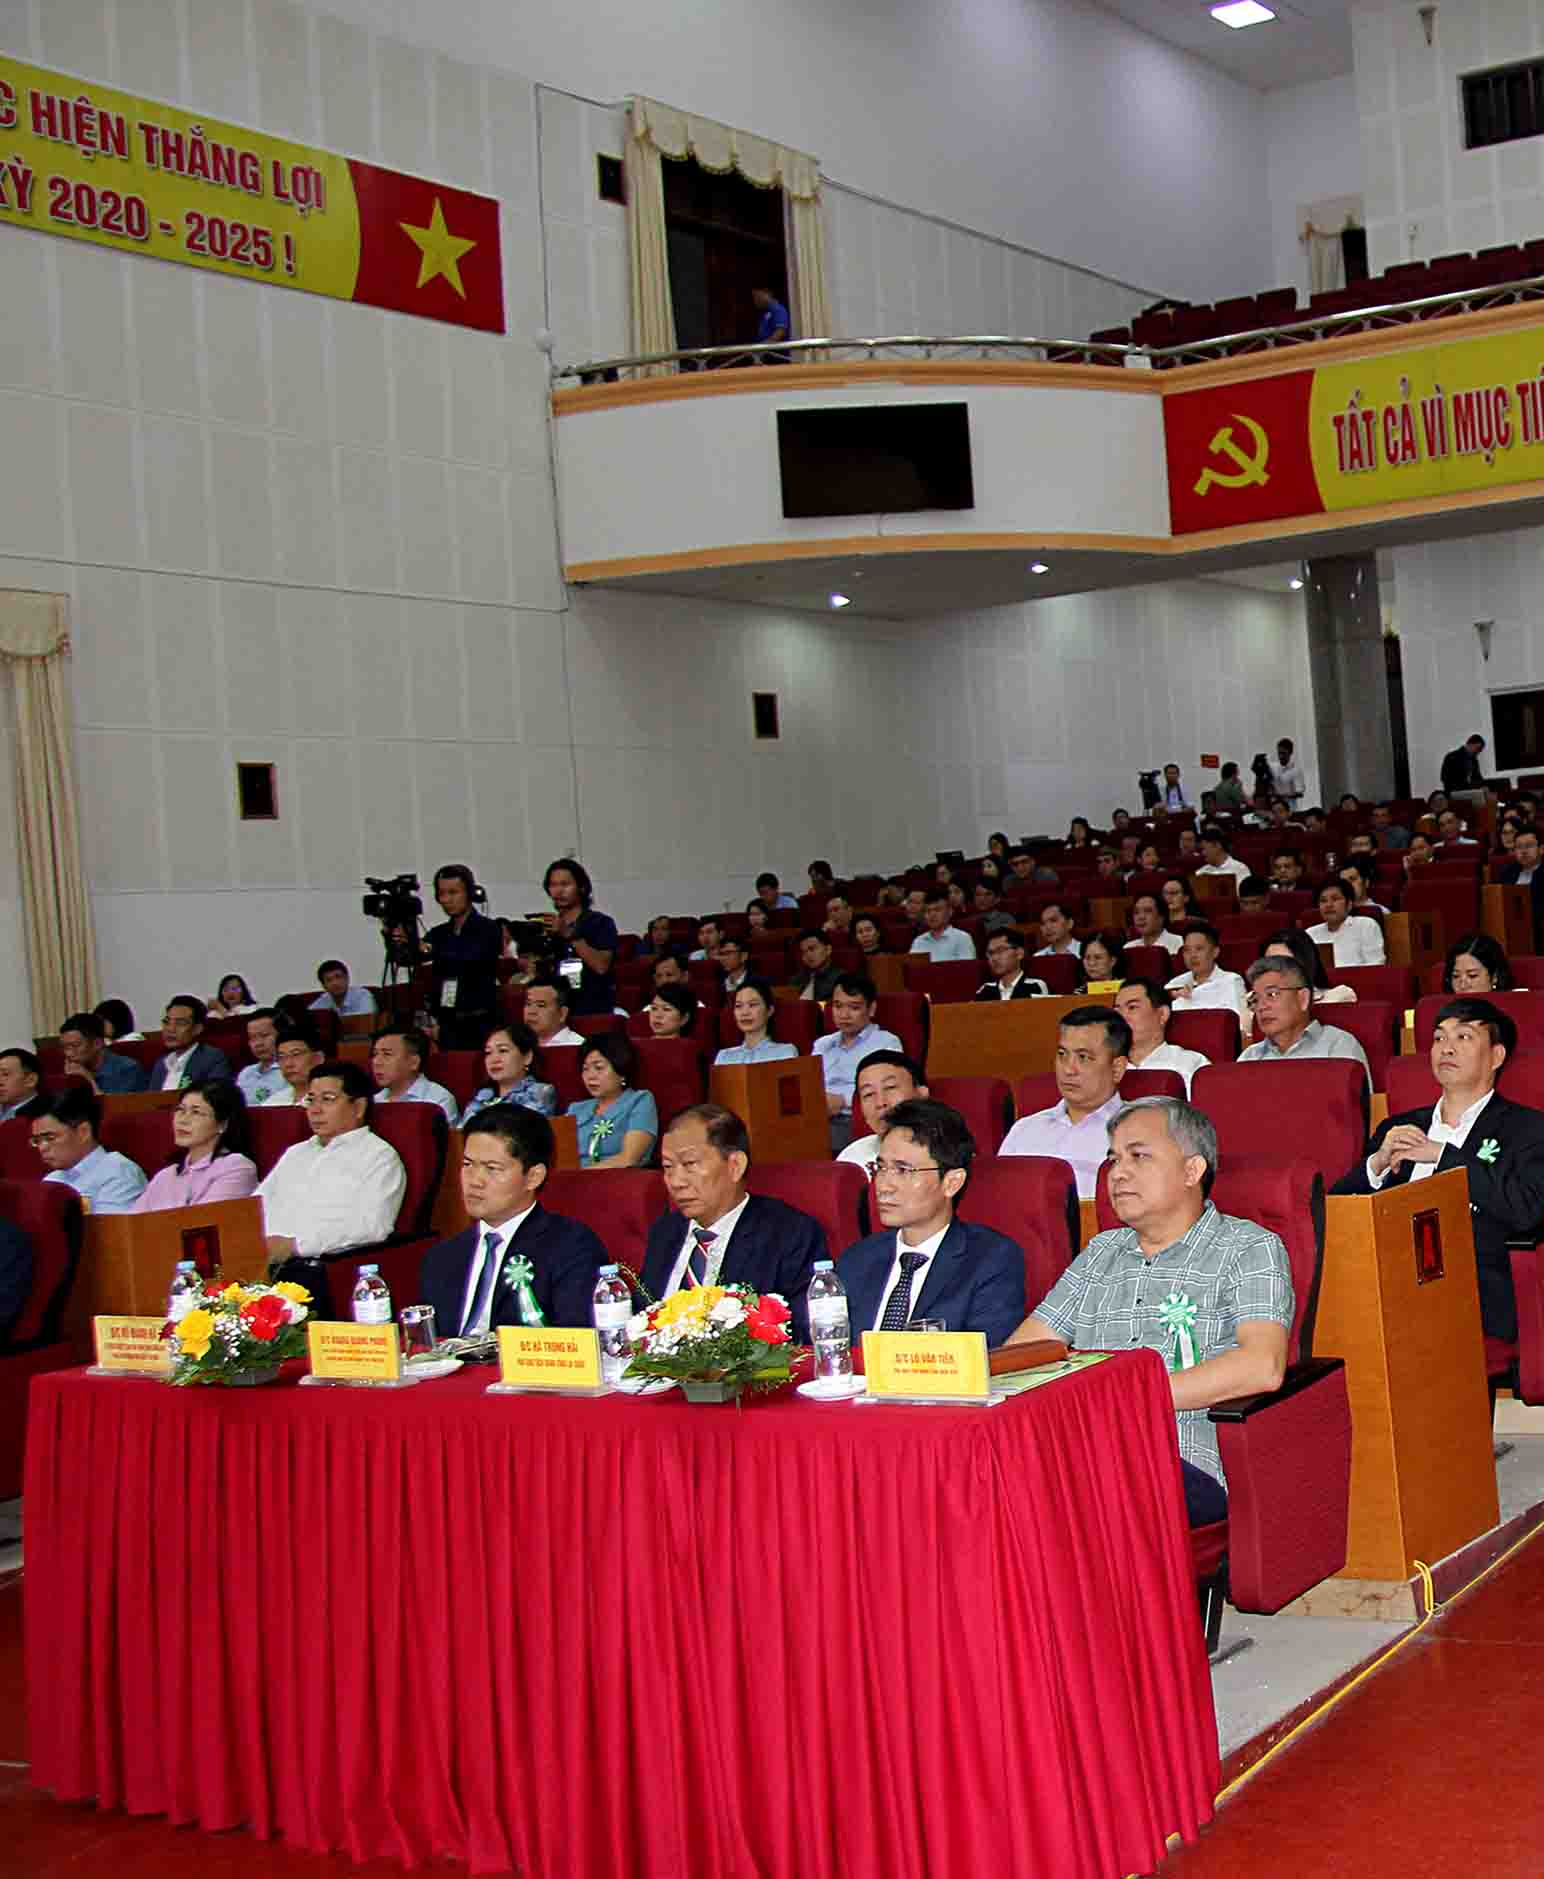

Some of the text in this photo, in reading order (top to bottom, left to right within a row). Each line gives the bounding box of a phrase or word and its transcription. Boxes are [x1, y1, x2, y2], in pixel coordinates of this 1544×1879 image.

[0, 80, 326, 214] C HIỆN THẮNG LỢI
[49, 175, 148, 241] 2020
[185, 210, 273, 268] 2025
[1332, 389, 1376, 473] TẤT
[1383, 376, 1417, 465] CẢ
[1421, 384, 1448, 461] VÌ
[1453, 385, 1512, 464] MỤC
